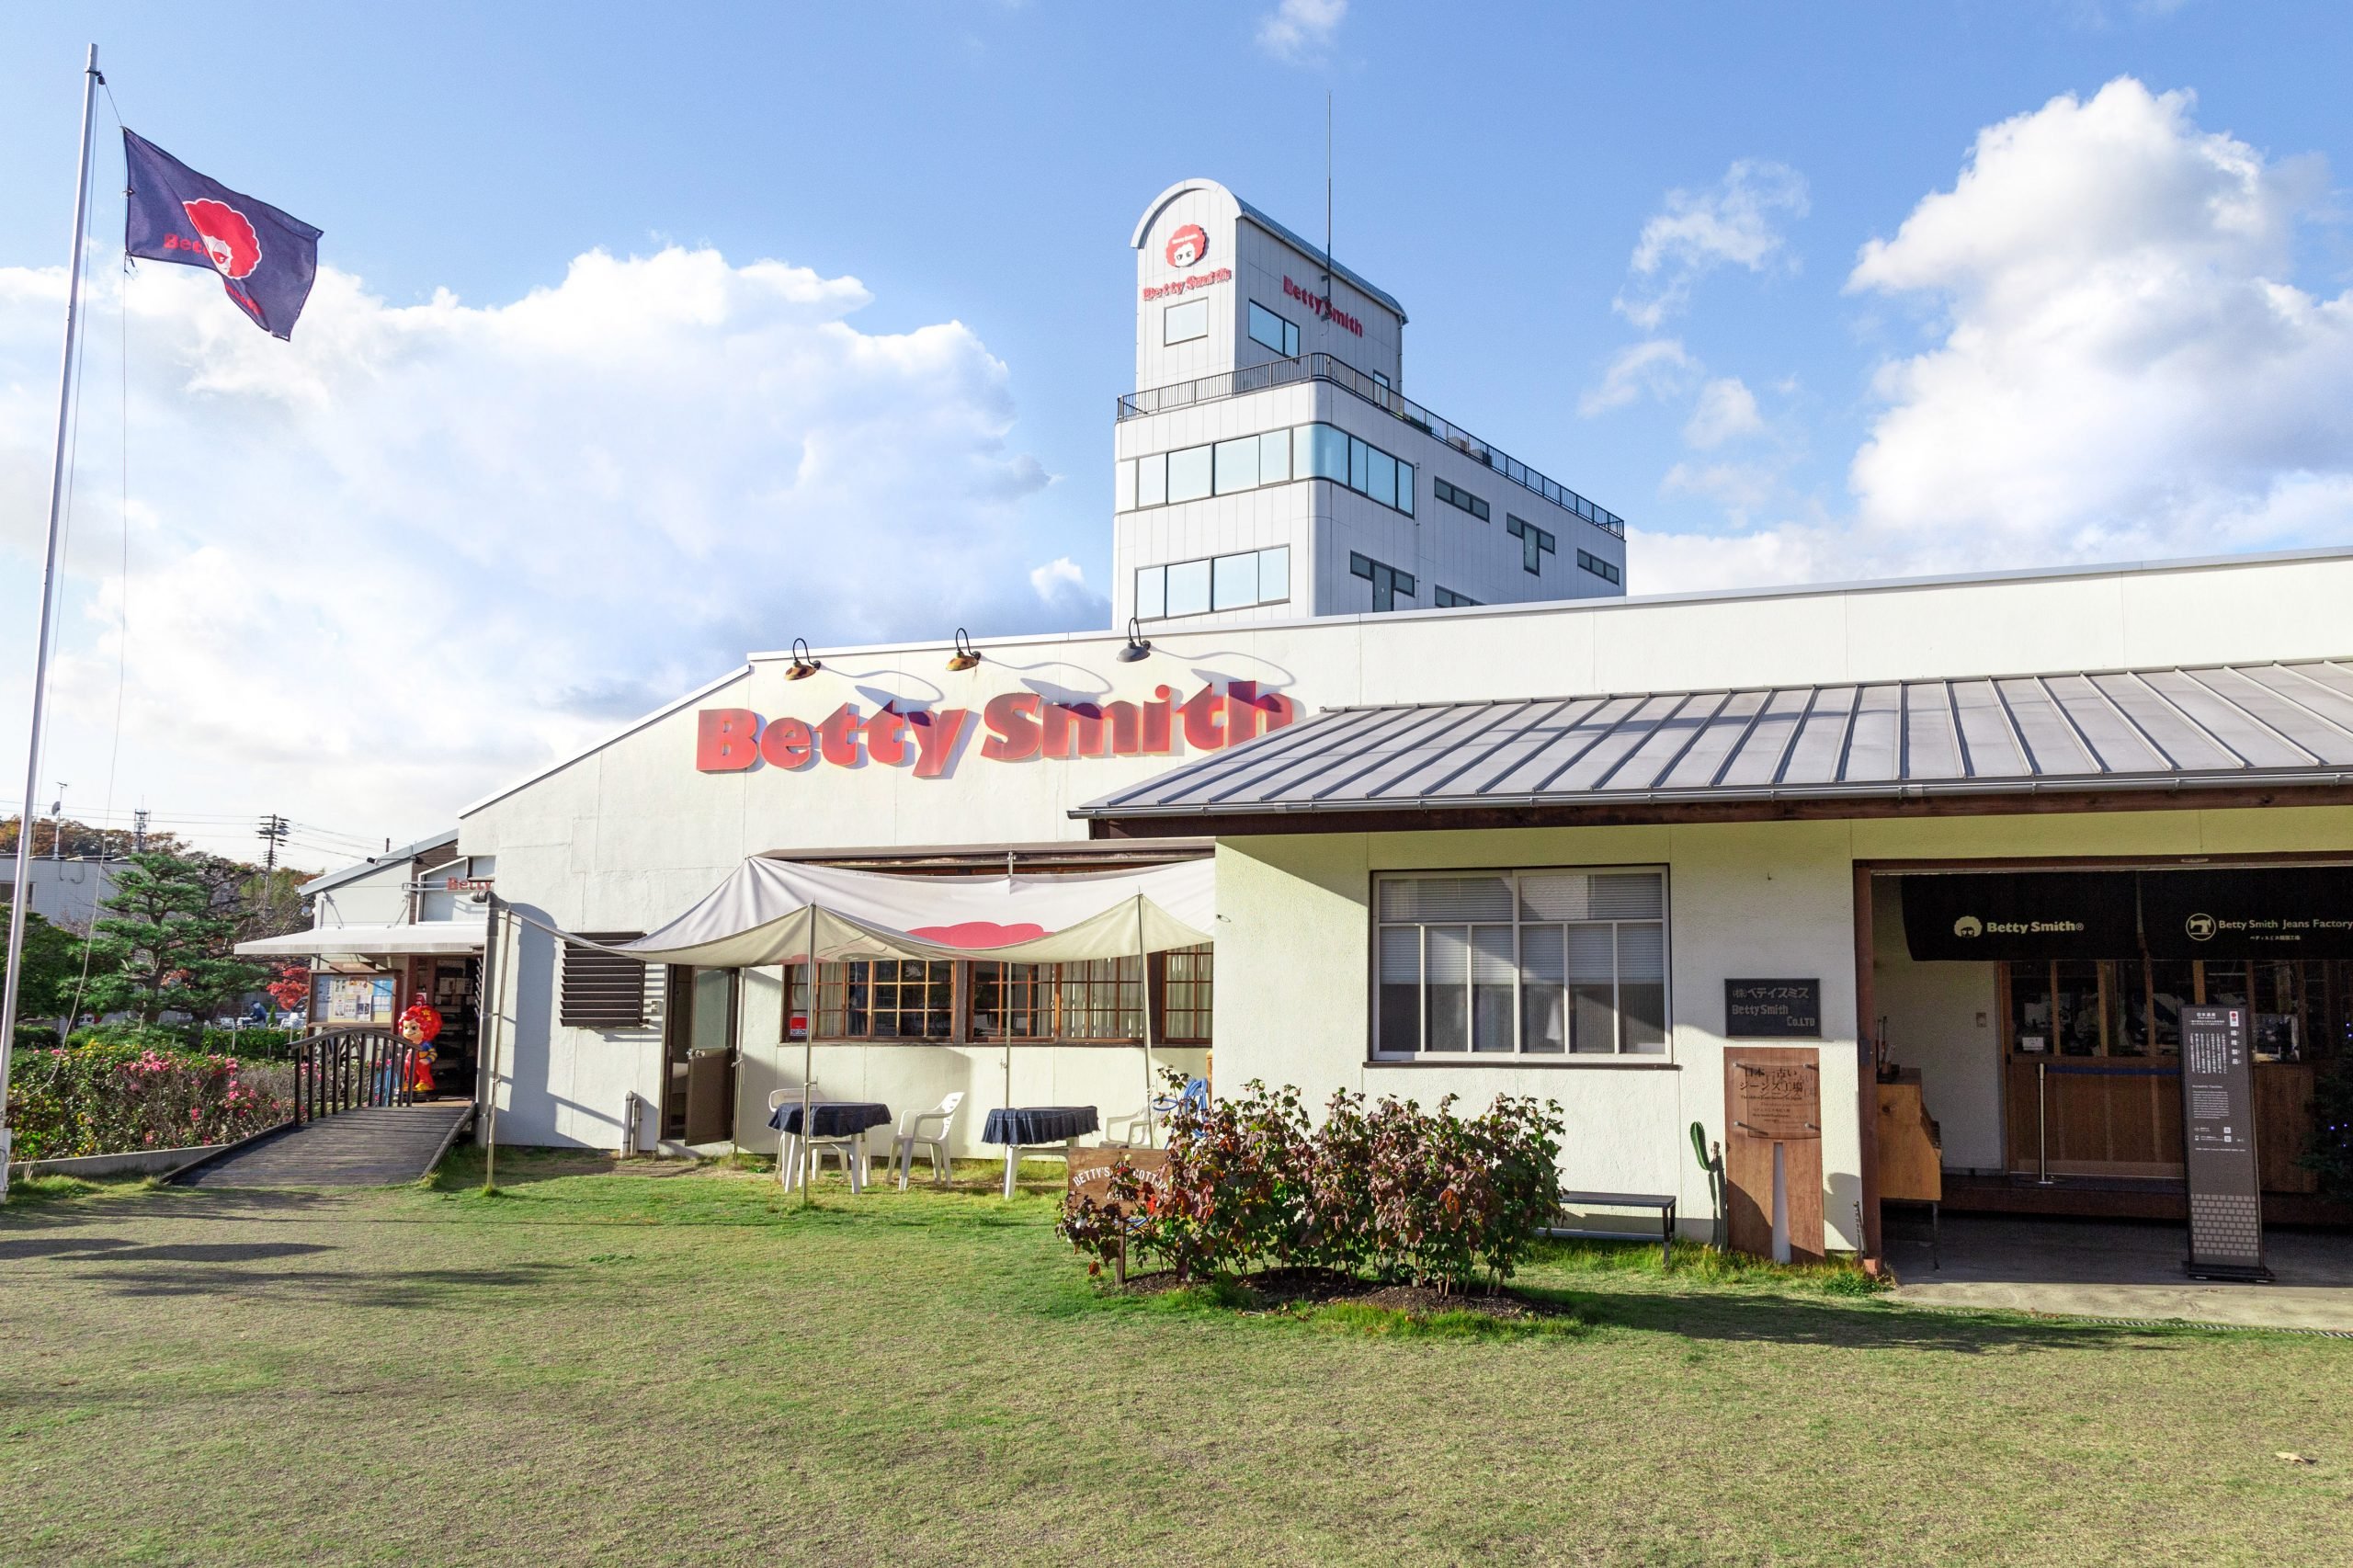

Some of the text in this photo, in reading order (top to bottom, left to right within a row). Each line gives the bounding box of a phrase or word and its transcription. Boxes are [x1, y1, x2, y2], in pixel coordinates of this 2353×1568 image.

[164, 233, 209, 257] Bet
[1283, 275, 1322, 315] Betty
[697, 680, 1294, 778] Betty Smith
[1986, 922, 2029, 934] Betty
[2219, 919, 2353, 930] Betty Smith Jeans Factory
[1073, 1166, 1112, 1187] BETTY'S
